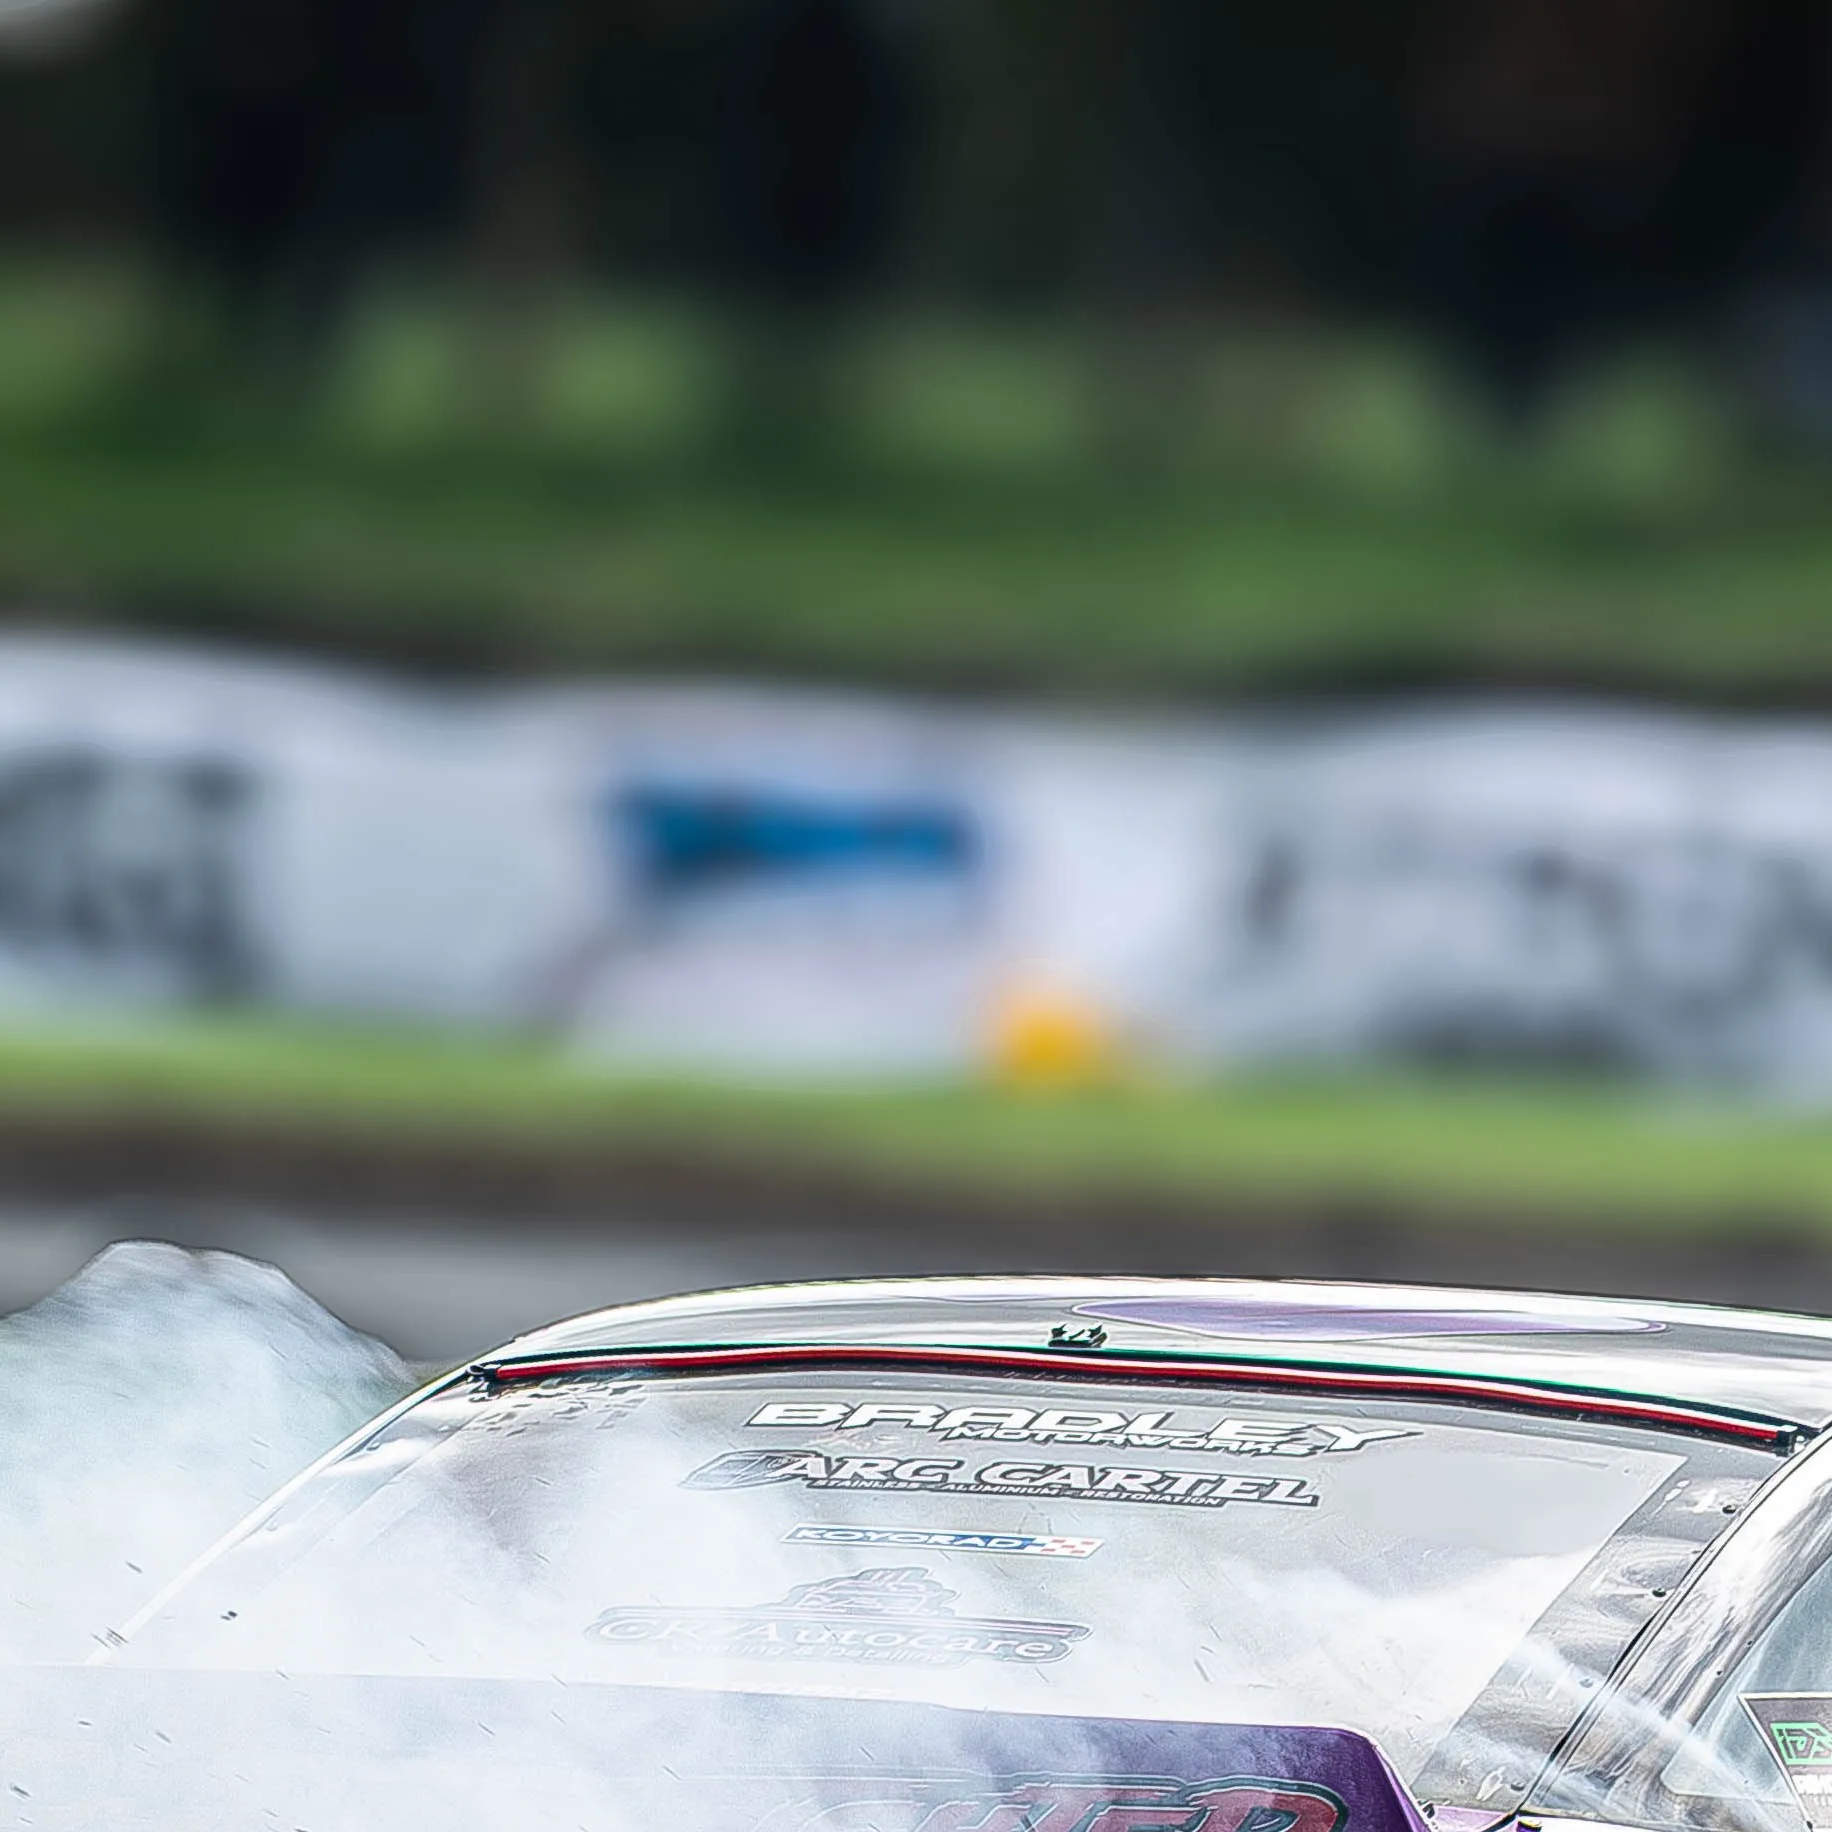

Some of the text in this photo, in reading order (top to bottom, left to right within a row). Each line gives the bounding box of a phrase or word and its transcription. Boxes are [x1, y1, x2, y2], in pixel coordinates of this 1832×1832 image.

[747, 1402, 1423, 1453] BRADLEY
[941, 1427, 1319, 1457] MOTORWORKS
[769, 1454, 1318, 1506] ARC CARTEL
[940, 1482, 1059, 1496] ALUMINIUM
[1081, 1490, 1221, 1506] RESTORATION
[795, 1527, 1019, 1551] KOYORAD
[728, 1620, 1054, 1658] Autocare
